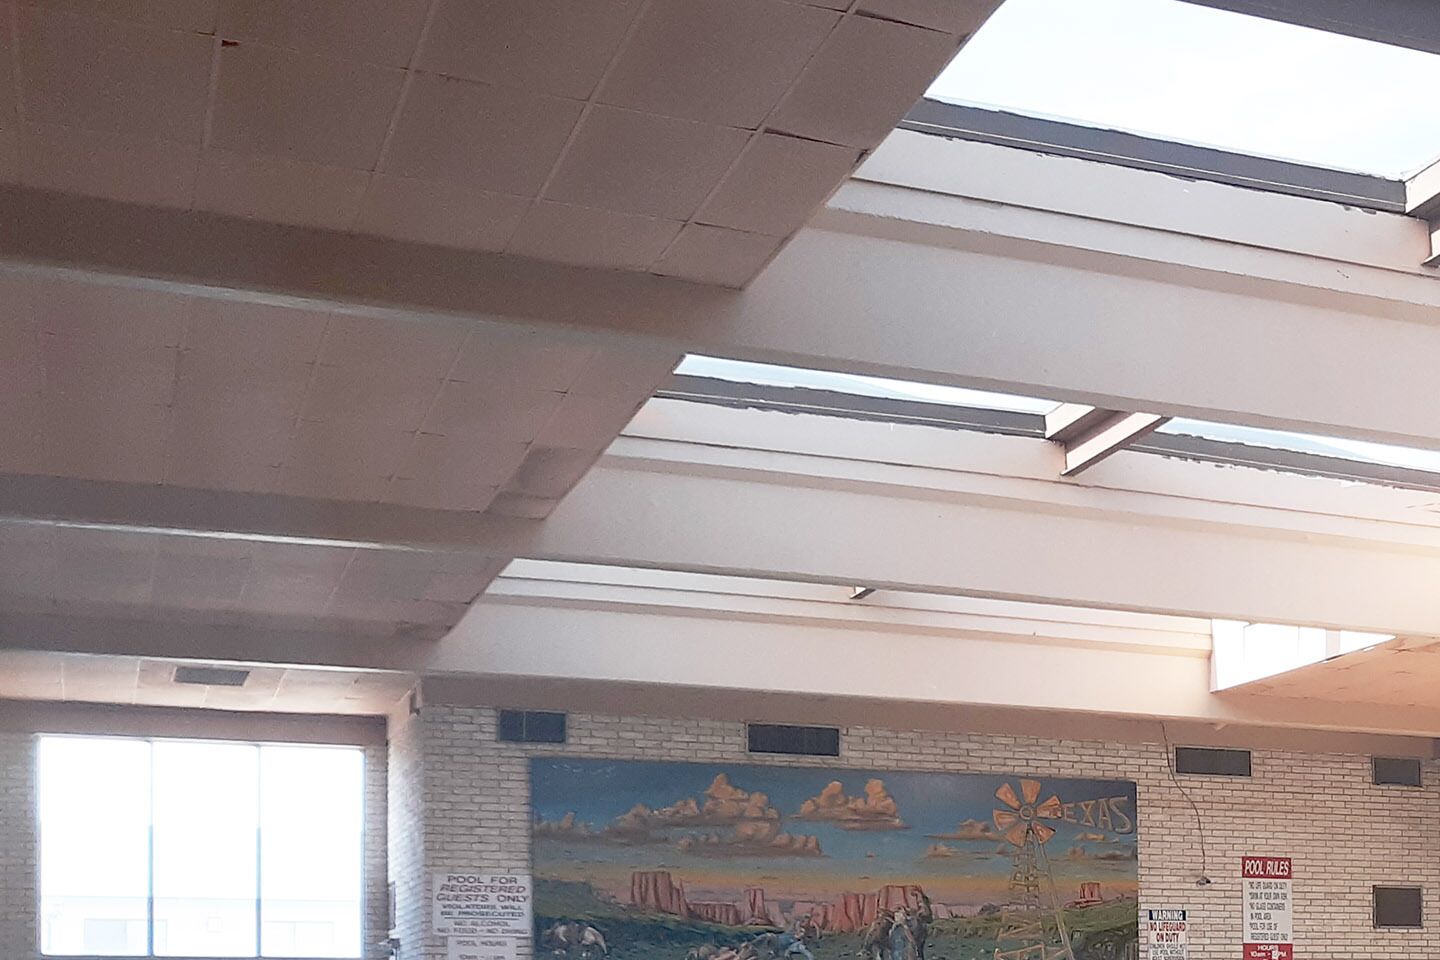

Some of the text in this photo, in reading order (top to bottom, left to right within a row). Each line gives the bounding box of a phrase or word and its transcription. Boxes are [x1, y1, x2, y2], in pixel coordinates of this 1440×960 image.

[1244, 860, 1289, 875] POOL RULES
[447, 875, 518, 884] POOL FOR
[440, 884, 526, 894] REGISTERED
[436, 893, 529, 903] GUESTS ONLY
[1152, 910, 1183, 920] WARNING
[1150, 922, 1186, 932] NO LIFEGUARD
[1156, 933, 1180, 942] ON DUTY
